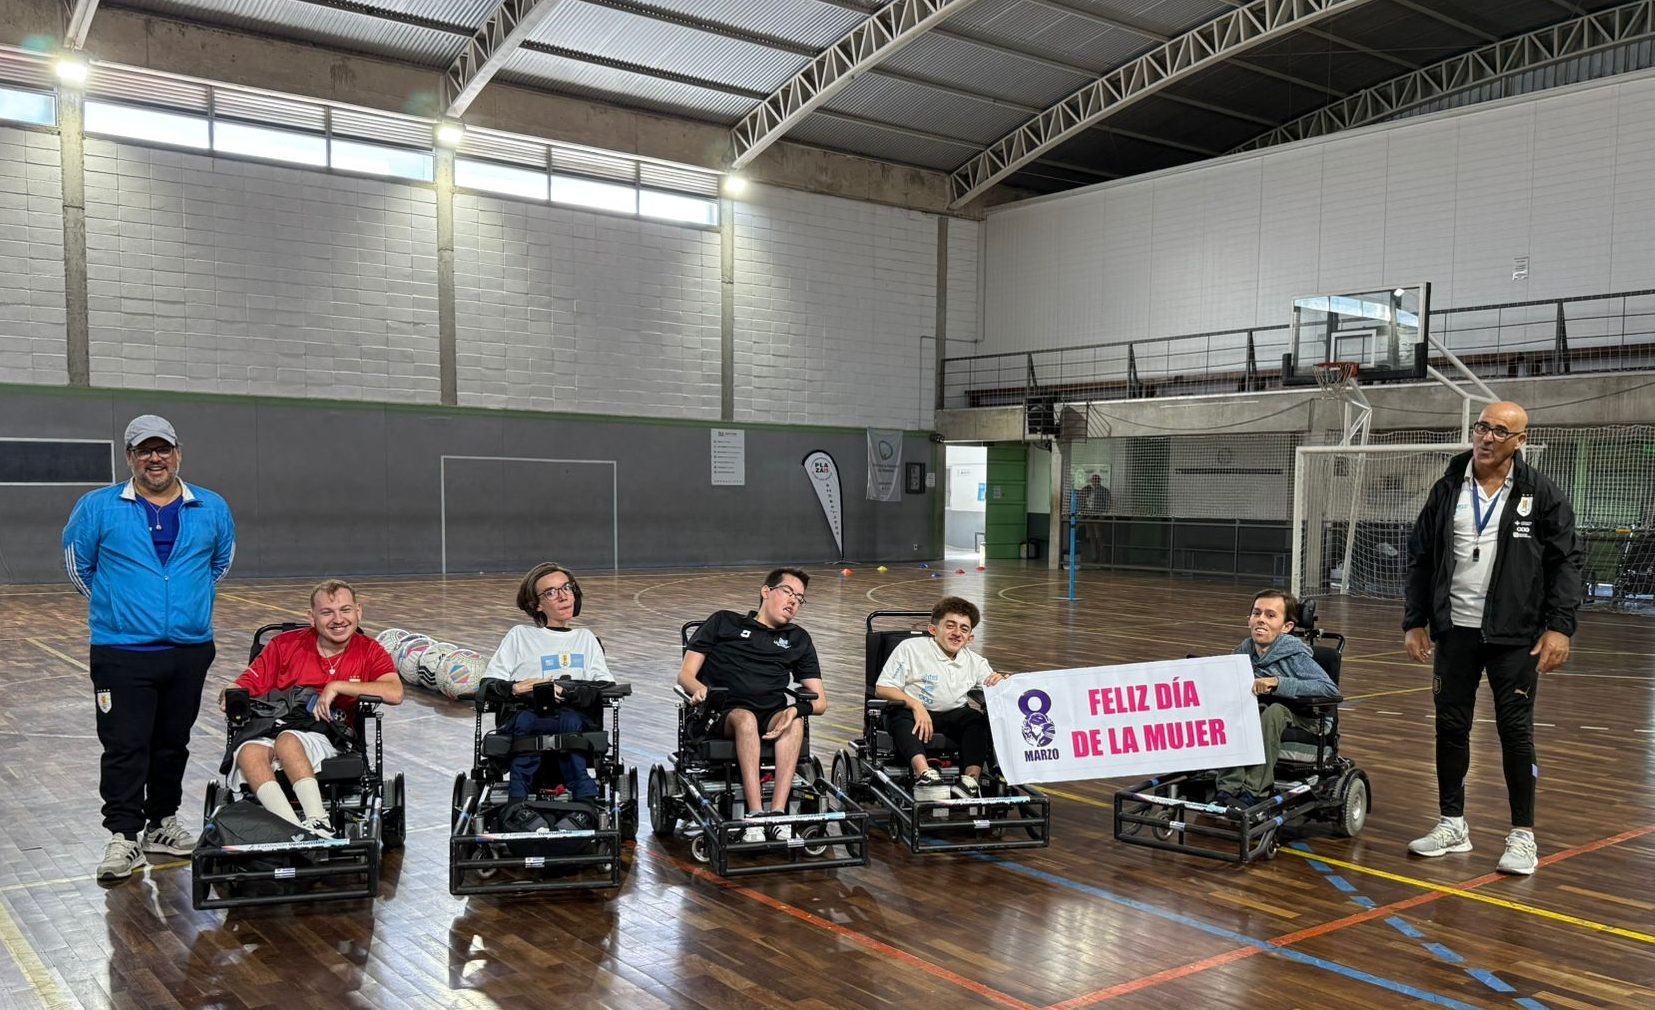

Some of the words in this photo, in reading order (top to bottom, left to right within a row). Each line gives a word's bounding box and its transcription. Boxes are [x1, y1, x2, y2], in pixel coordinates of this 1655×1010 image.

[1088, 684, 1150, 716] FELIZ
[1154, 676, 1201, 710] DÍA
[1024, 748, 1060, 762] MARZO
[1071, 729, 1104, 758] DE
[1108, 726, 1140, 755] LA
[1143, 718, 1227, 751] MUJER
